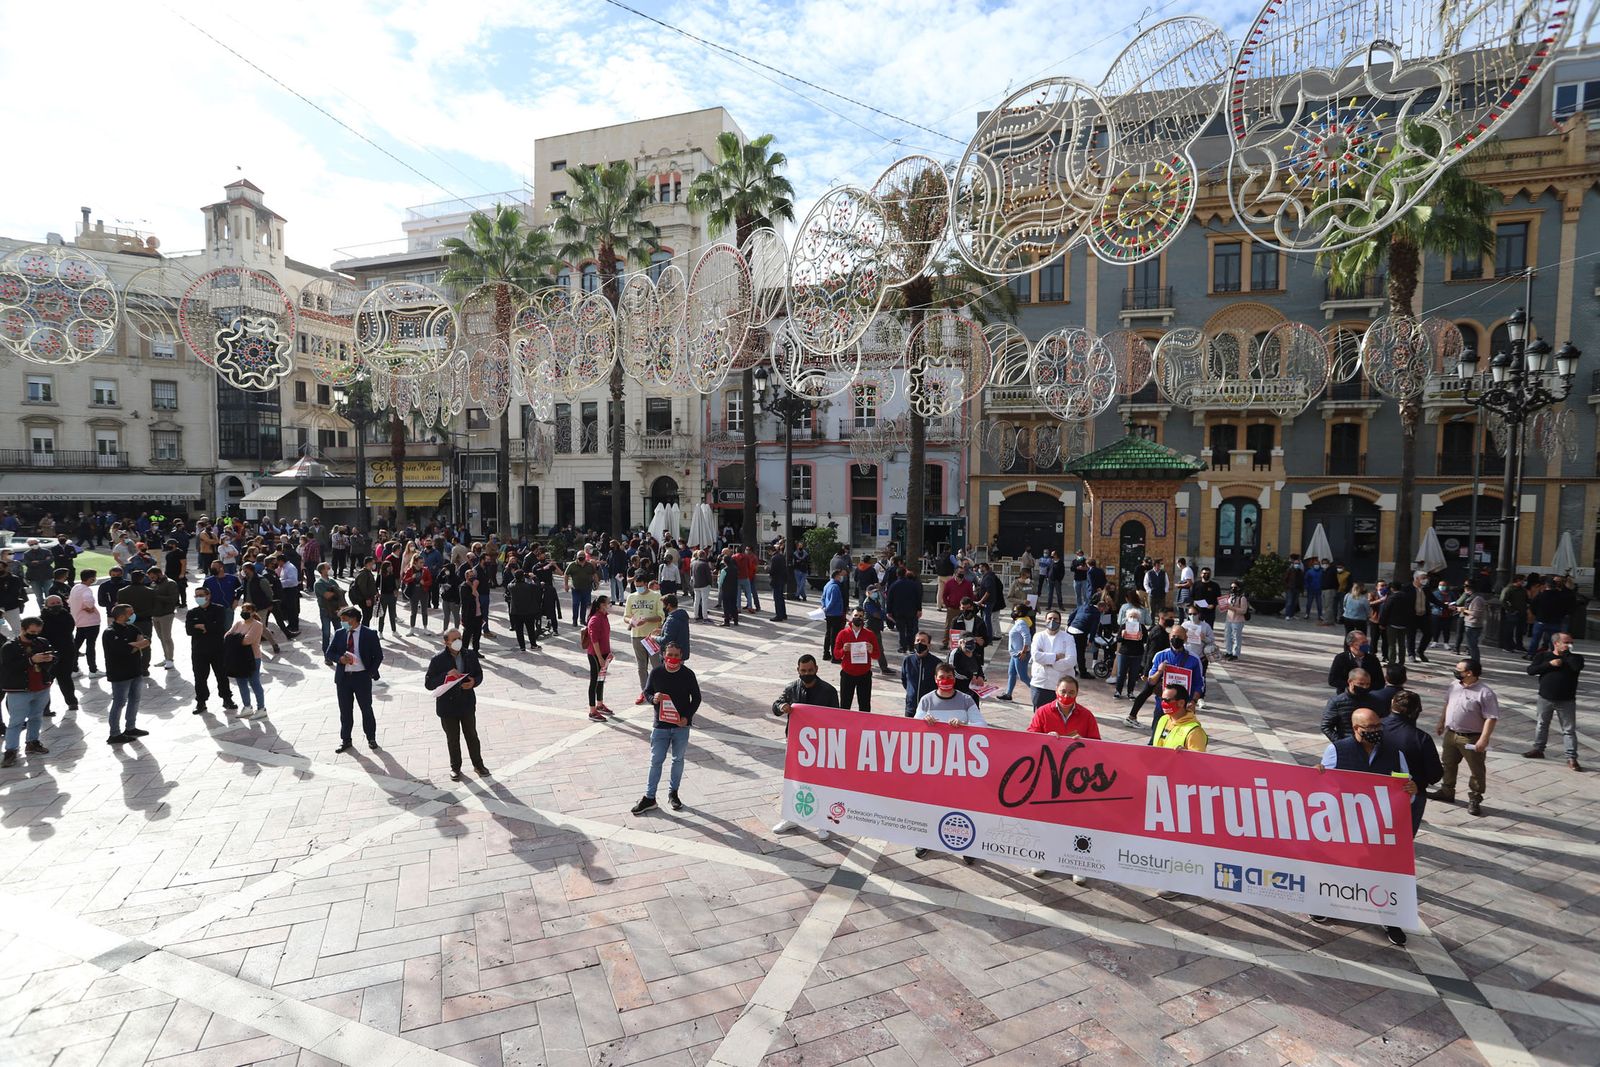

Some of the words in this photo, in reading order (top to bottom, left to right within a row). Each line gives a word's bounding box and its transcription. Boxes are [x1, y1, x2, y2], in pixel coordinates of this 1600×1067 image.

[798, 726, 846, 769] SIN
[857, 730, 989, 777] AYUDAS
[999, 742, 1117, 808] Nos
[874, 813, 896, 822] Provincial
[904, 819, 928, 828] Empresas
[1144, 775, 1397, 846] Arruinan!
[907, 825, 928, 833] Granada
[943, 826, 970, 836] HORECA
[981, 841, 1046, 861] HOSTECOR
[1058, 857, 1106, 871] HOSTELEROS
[1118, 848, 1204, 875] Hosturjaén
